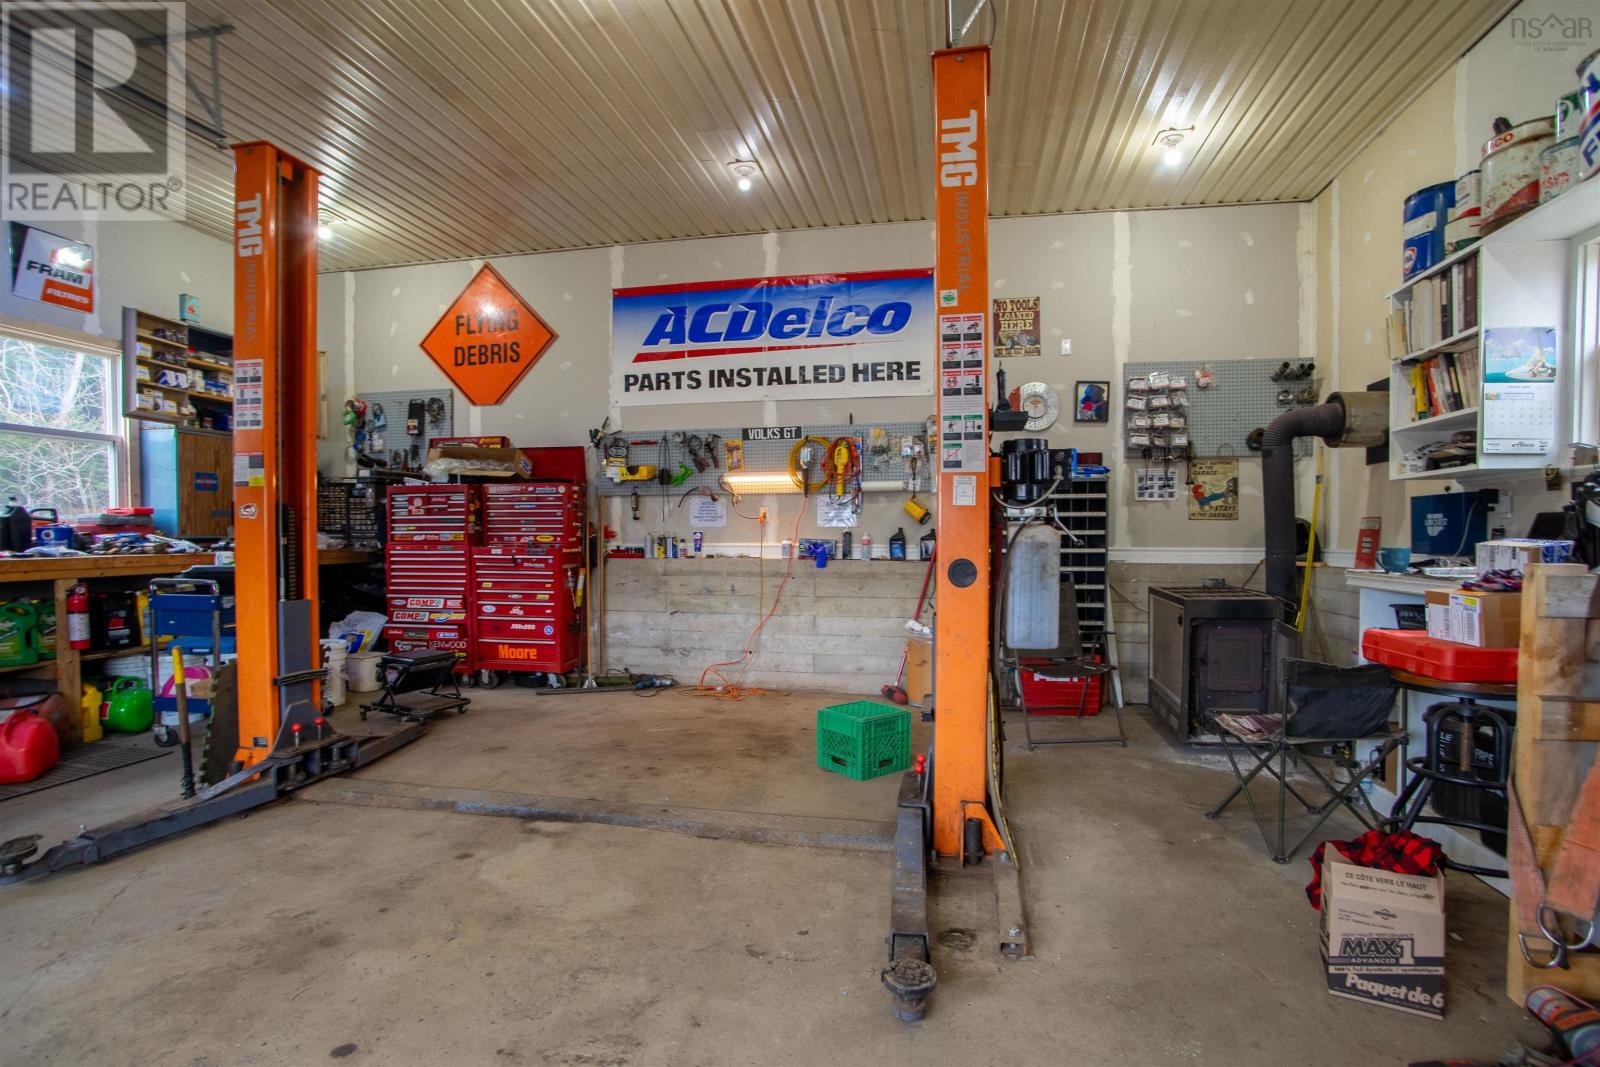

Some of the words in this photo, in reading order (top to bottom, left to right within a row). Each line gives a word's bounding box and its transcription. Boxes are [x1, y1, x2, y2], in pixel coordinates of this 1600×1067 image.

[940, 109, 977, 187] TMG
[237, 192, 264, 257] TMG
[26, 260, 84, 285] FRAM
[993, 300, 1007, 312] NO
[1009, 298, 1038, 311] TOOLS
[999, 311, 1034, 320] LOANED
[456, 309, 519, 336] FLYING
[642, 296, 913, 346] ACDelco
[1000, 320, 1033, 330] HERE
[454, 341, 521, 367] DEBRIS
[624, 370, 701, 393] PARTS
[709, 364, 845, 388] INSTALLED
[852, 361, 921, 382] HERE
[748, 428, 780, 440] VOLKS
[784, 427, 797, 439] GT
[429, 640, 467, 649] KENWOOD
[498, 645, 537, 659] Moore
[1345, 872, 1354, 880] CE
[1375, 877, 1394, 886] VERS
[1396, 879, 1405, 887] LE
[1407, 882, 1426, 890] HAUT
[1345, 973, 1408, 996] Paquet
[1408, 986, 1431, 1005] de
[1431, 992, 1444, 1008] 6
